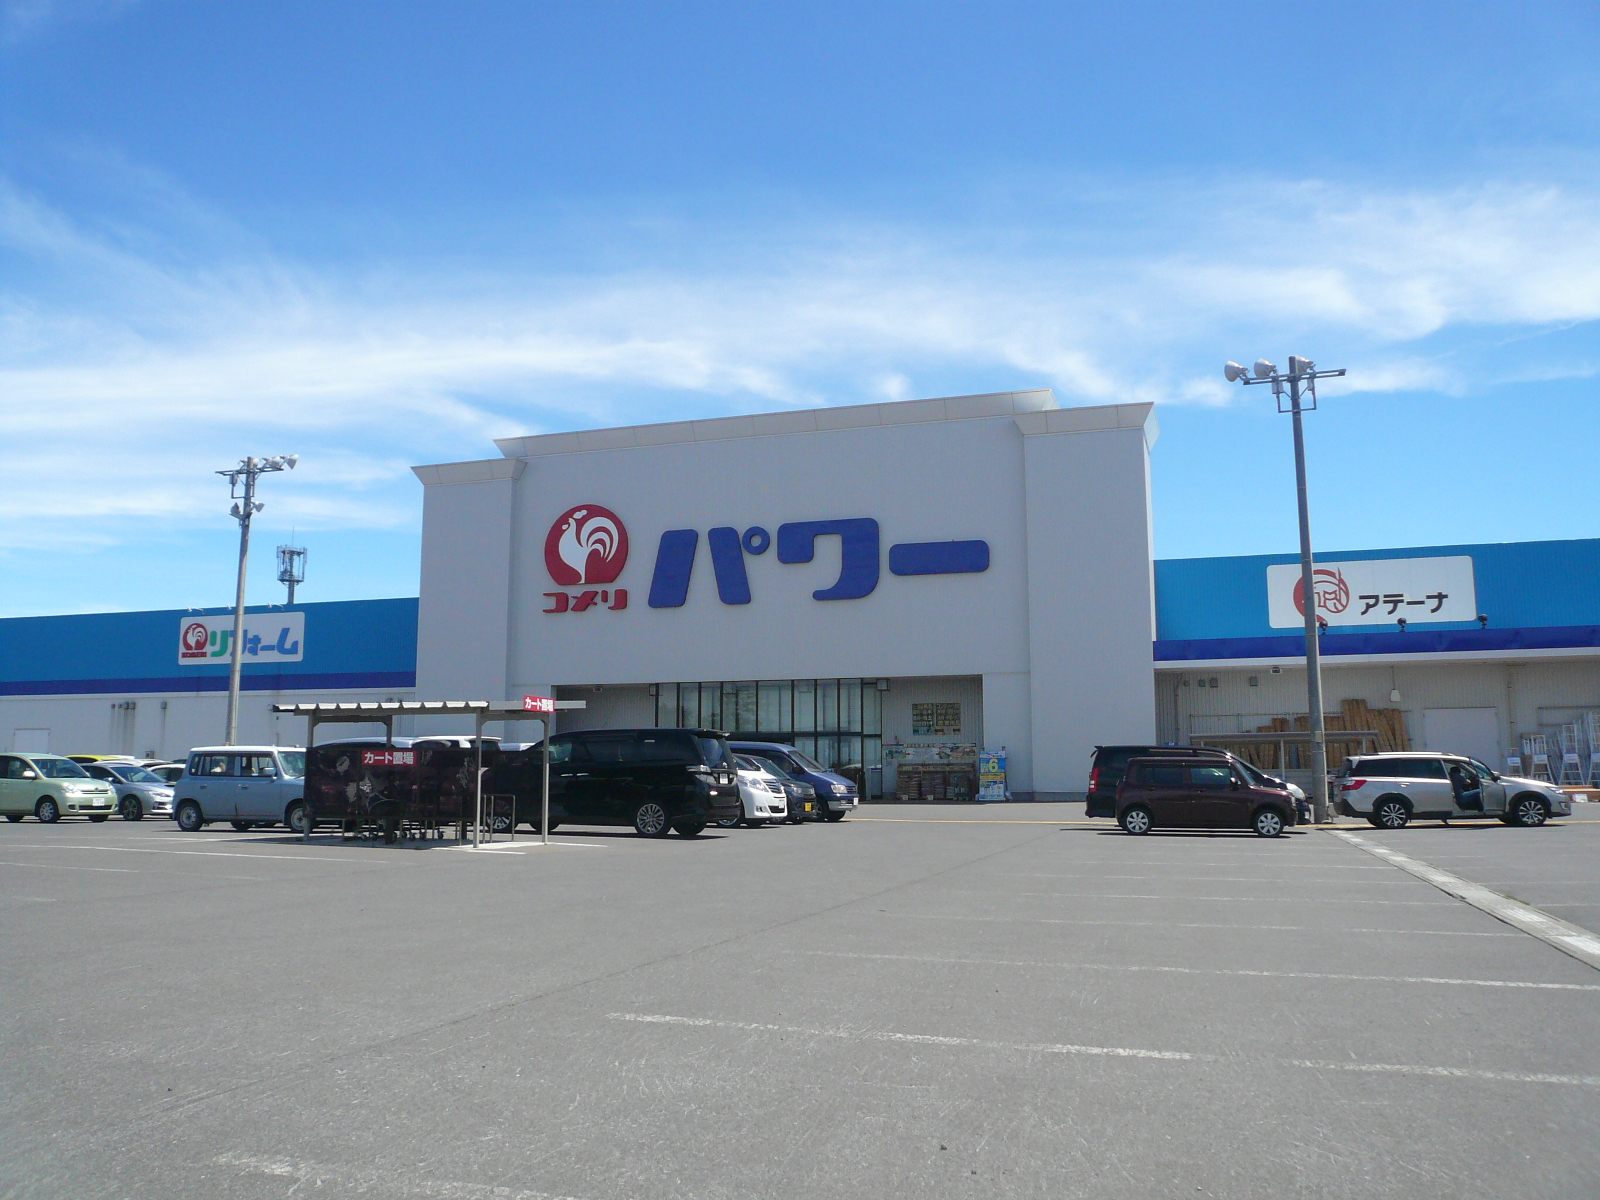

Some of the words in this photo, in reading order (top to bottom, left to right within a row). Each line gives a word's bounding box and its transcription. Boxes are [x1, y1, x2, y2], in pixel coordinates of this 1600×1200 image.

[648, 518, 990, 608] パワー
[543, 588, 628, 613] コメリ
[1358, 592, 1449, 616] アテーナ
[525, 697, 554, 712] カート置場
[364, 752, 414, 764] カート置場
